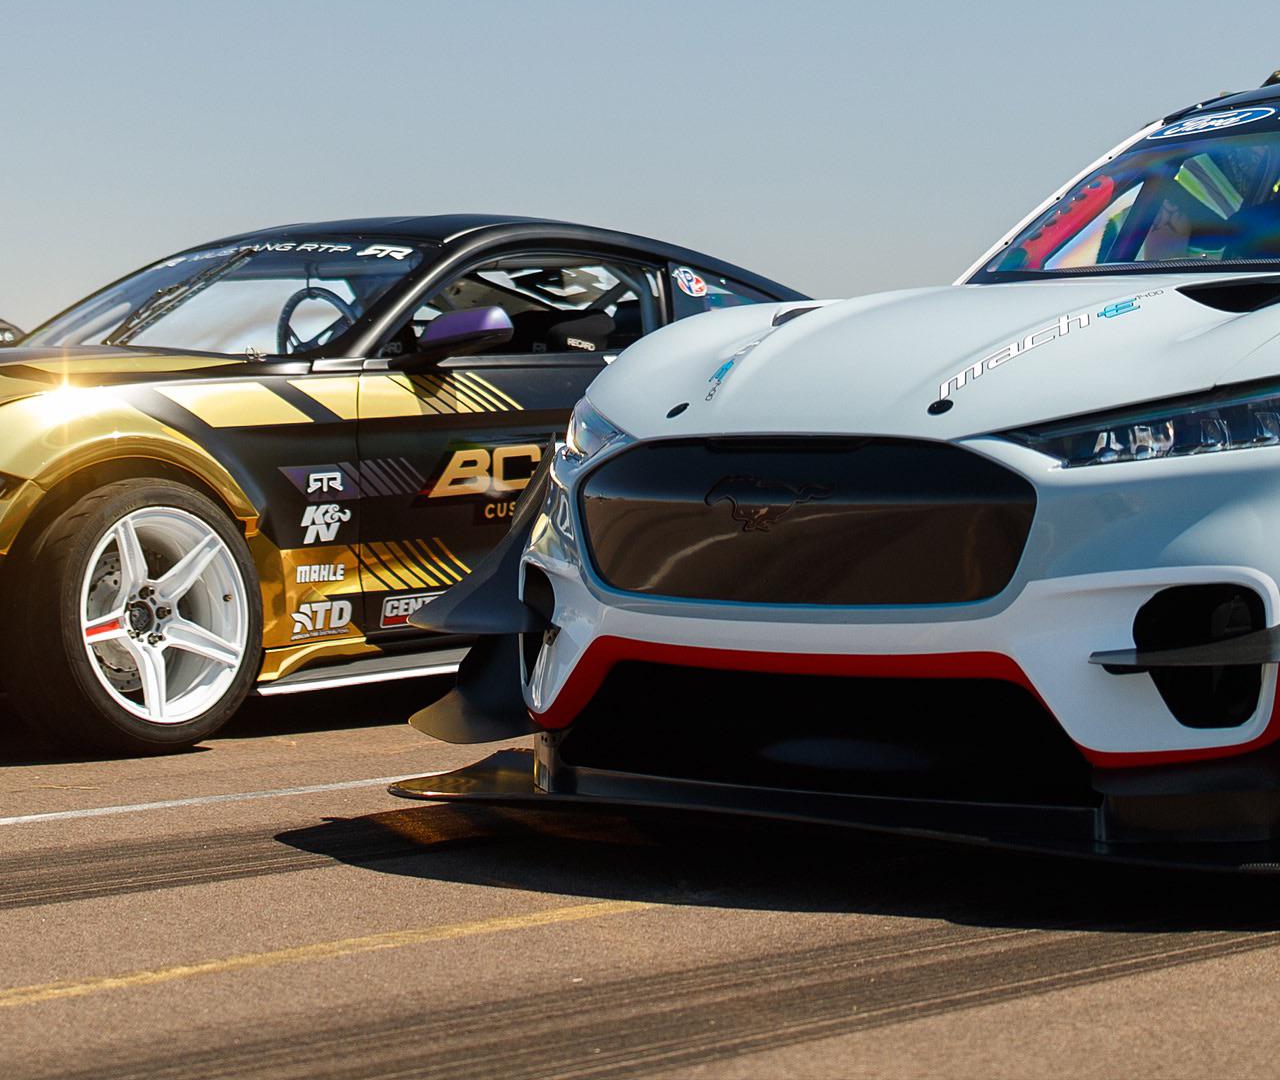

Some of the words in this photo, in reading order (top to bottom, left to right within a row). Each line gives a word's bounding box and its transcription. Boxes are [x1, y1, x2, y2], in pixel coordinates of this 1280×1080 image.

[307, 471, 344, 494] RTR
[295, 563, 345, 584] MAHLE
[290, 599, 353, 634] ATD
